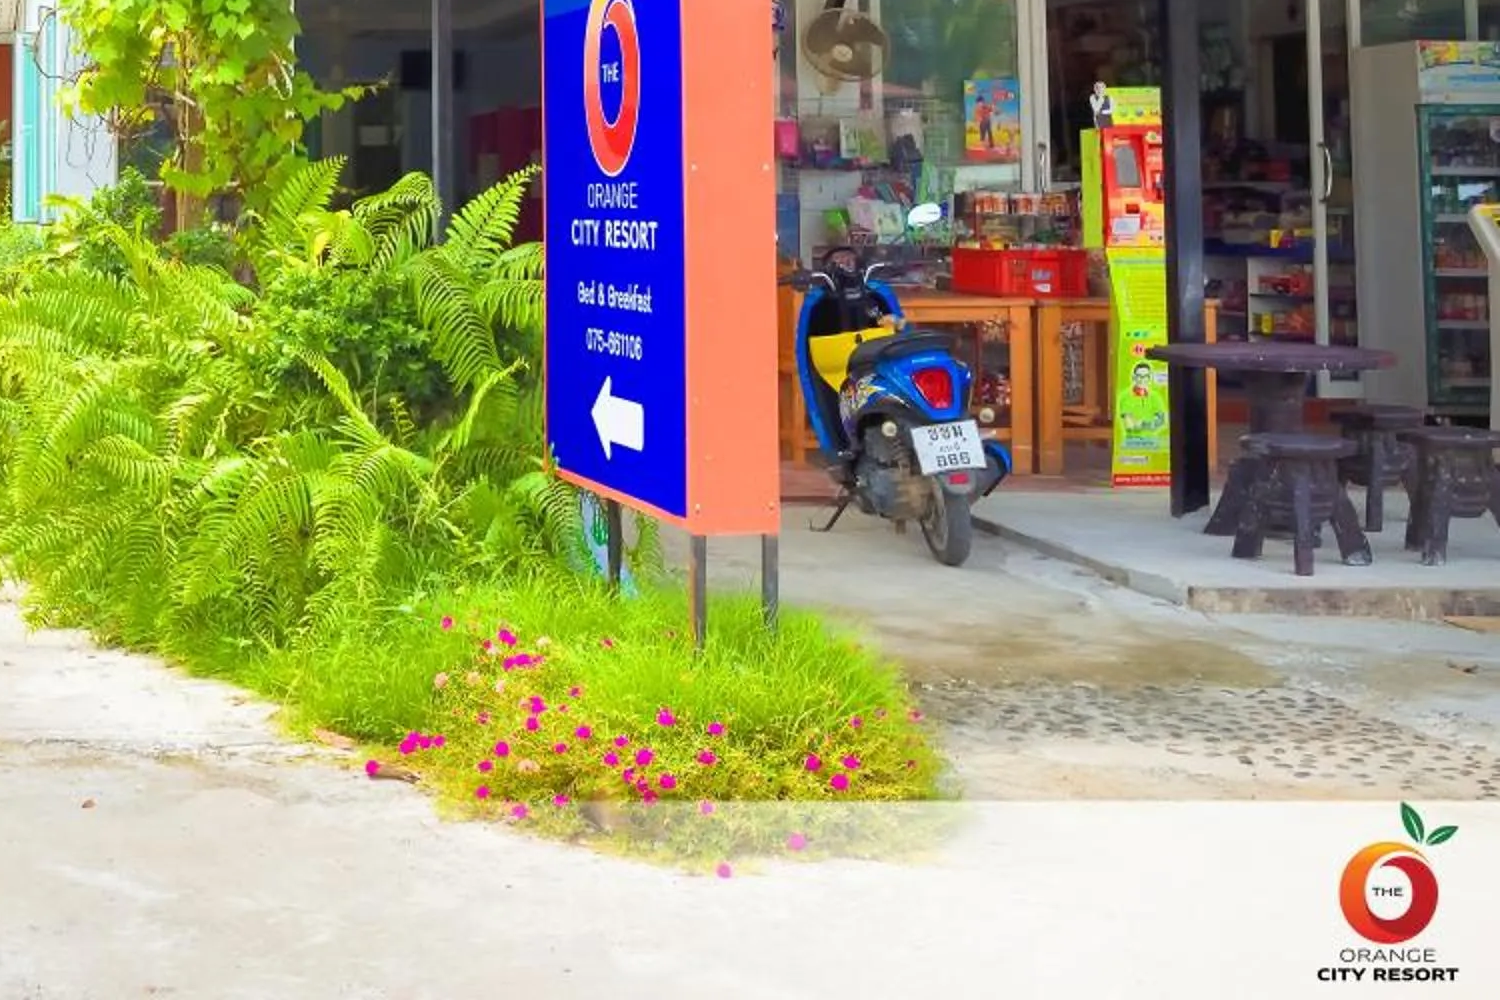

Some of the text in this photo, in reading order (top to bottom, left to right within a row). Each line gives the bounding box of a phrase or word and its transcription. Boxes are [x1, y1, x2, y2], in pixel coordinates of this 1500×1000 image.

[602, 61, 619, 83] THE
[587, 182, 639, 209] ORANGE
[571, 218, 659, 250] CITY RESORT
[577, 280, 653, 314] Bed & Breakfast
